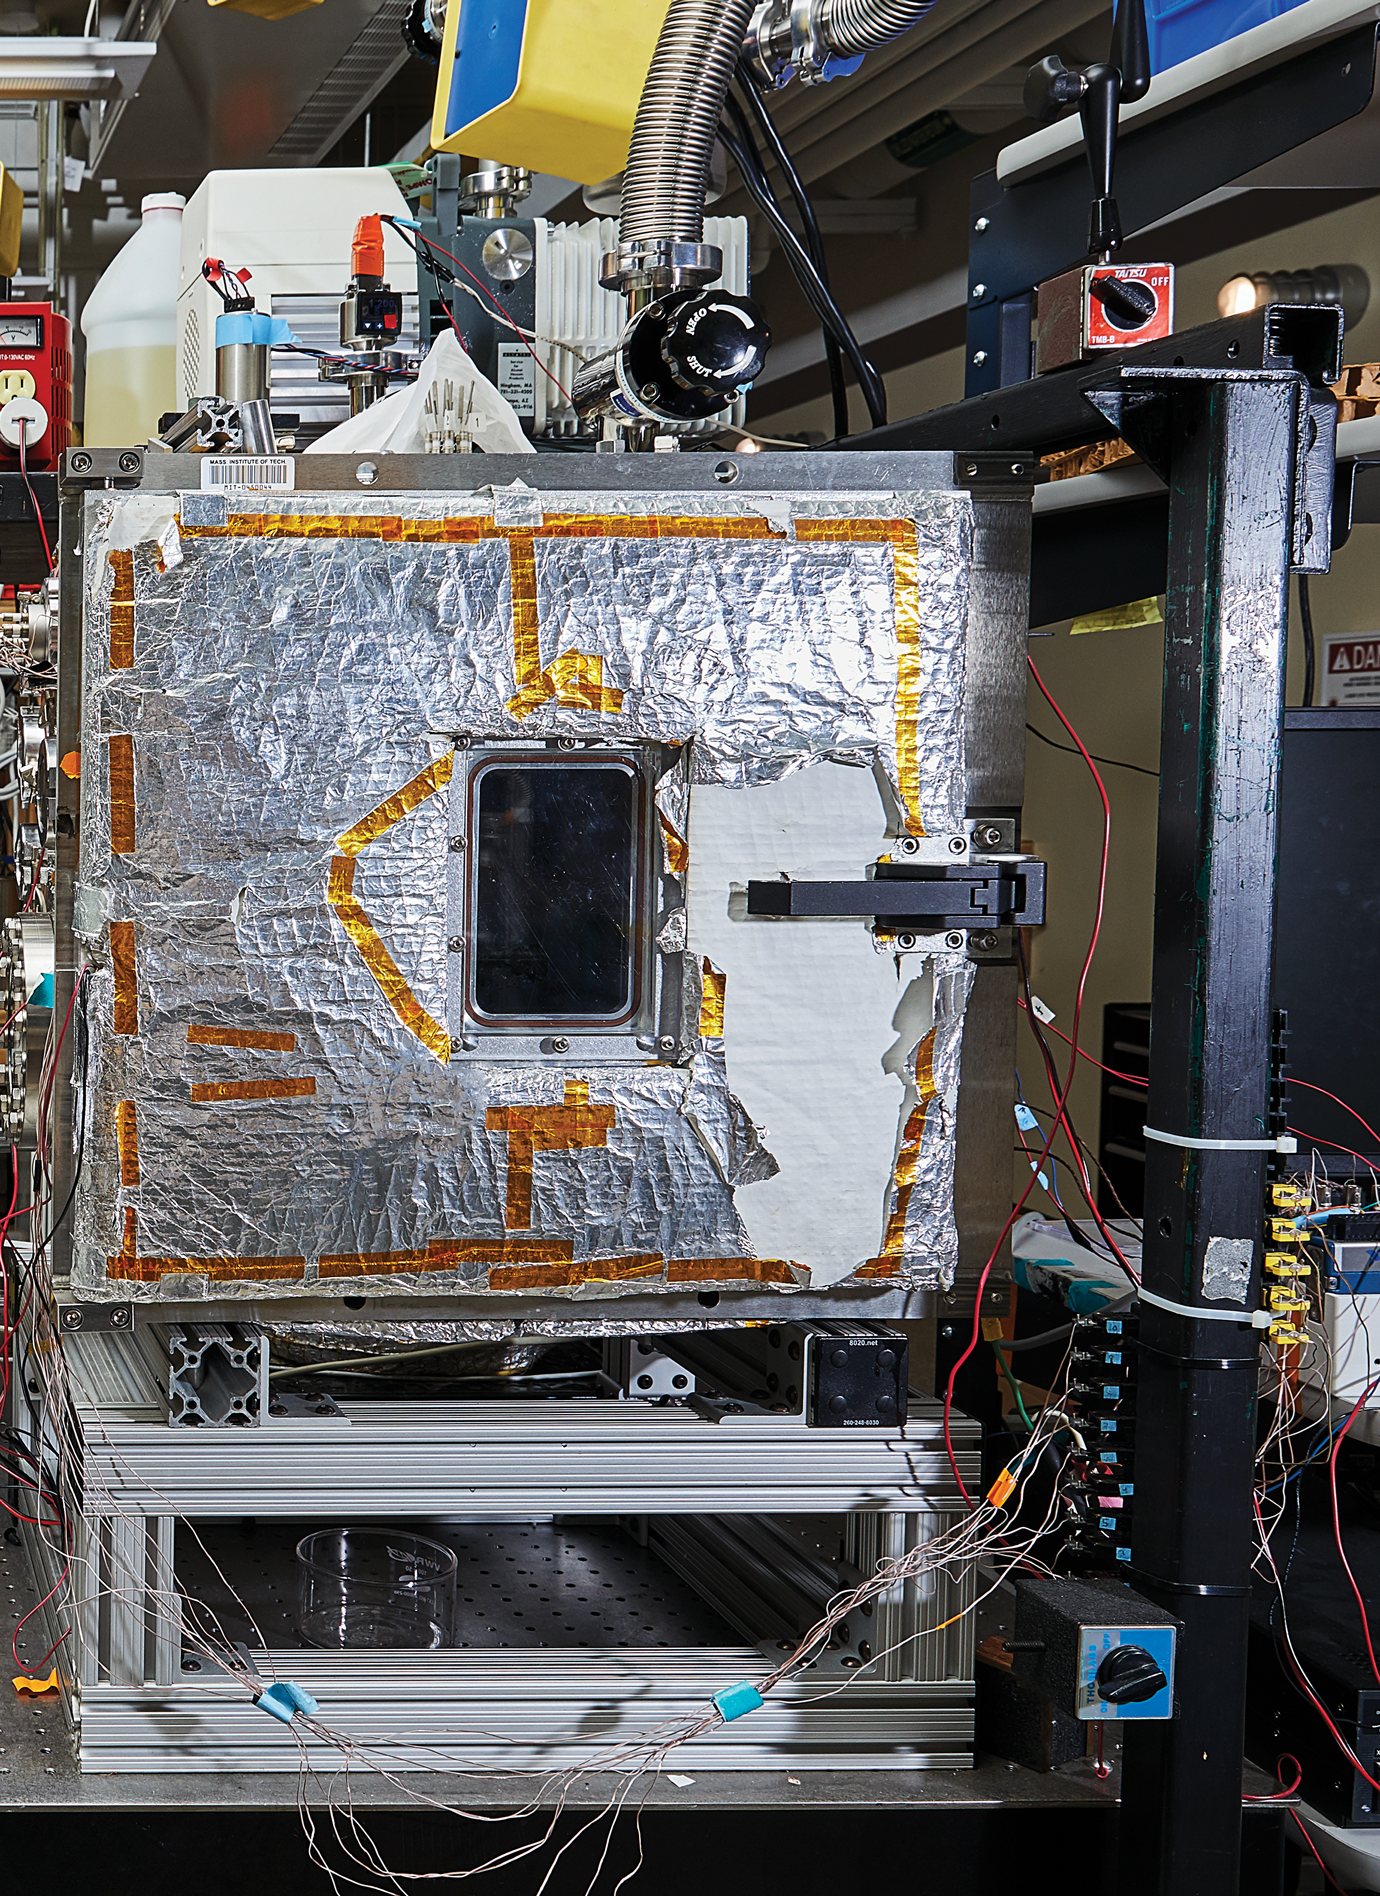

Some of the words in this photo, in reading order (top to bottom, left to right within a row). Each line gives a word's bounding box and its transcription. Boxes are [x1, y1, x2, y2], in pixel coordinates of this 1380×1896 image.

[1114, 268, 1148, 278] TAITSU
[1151, 277, 1169, 286] OFF
[686, 308, 708, 336] OPEN
[1092, 336, 1115, 344] TMB-B
[686, 355, 712, 378] SHUT
[1103, 1632, 1111, 1649] OFF
[1086, 1644, 1097, 1704] THORLABS
